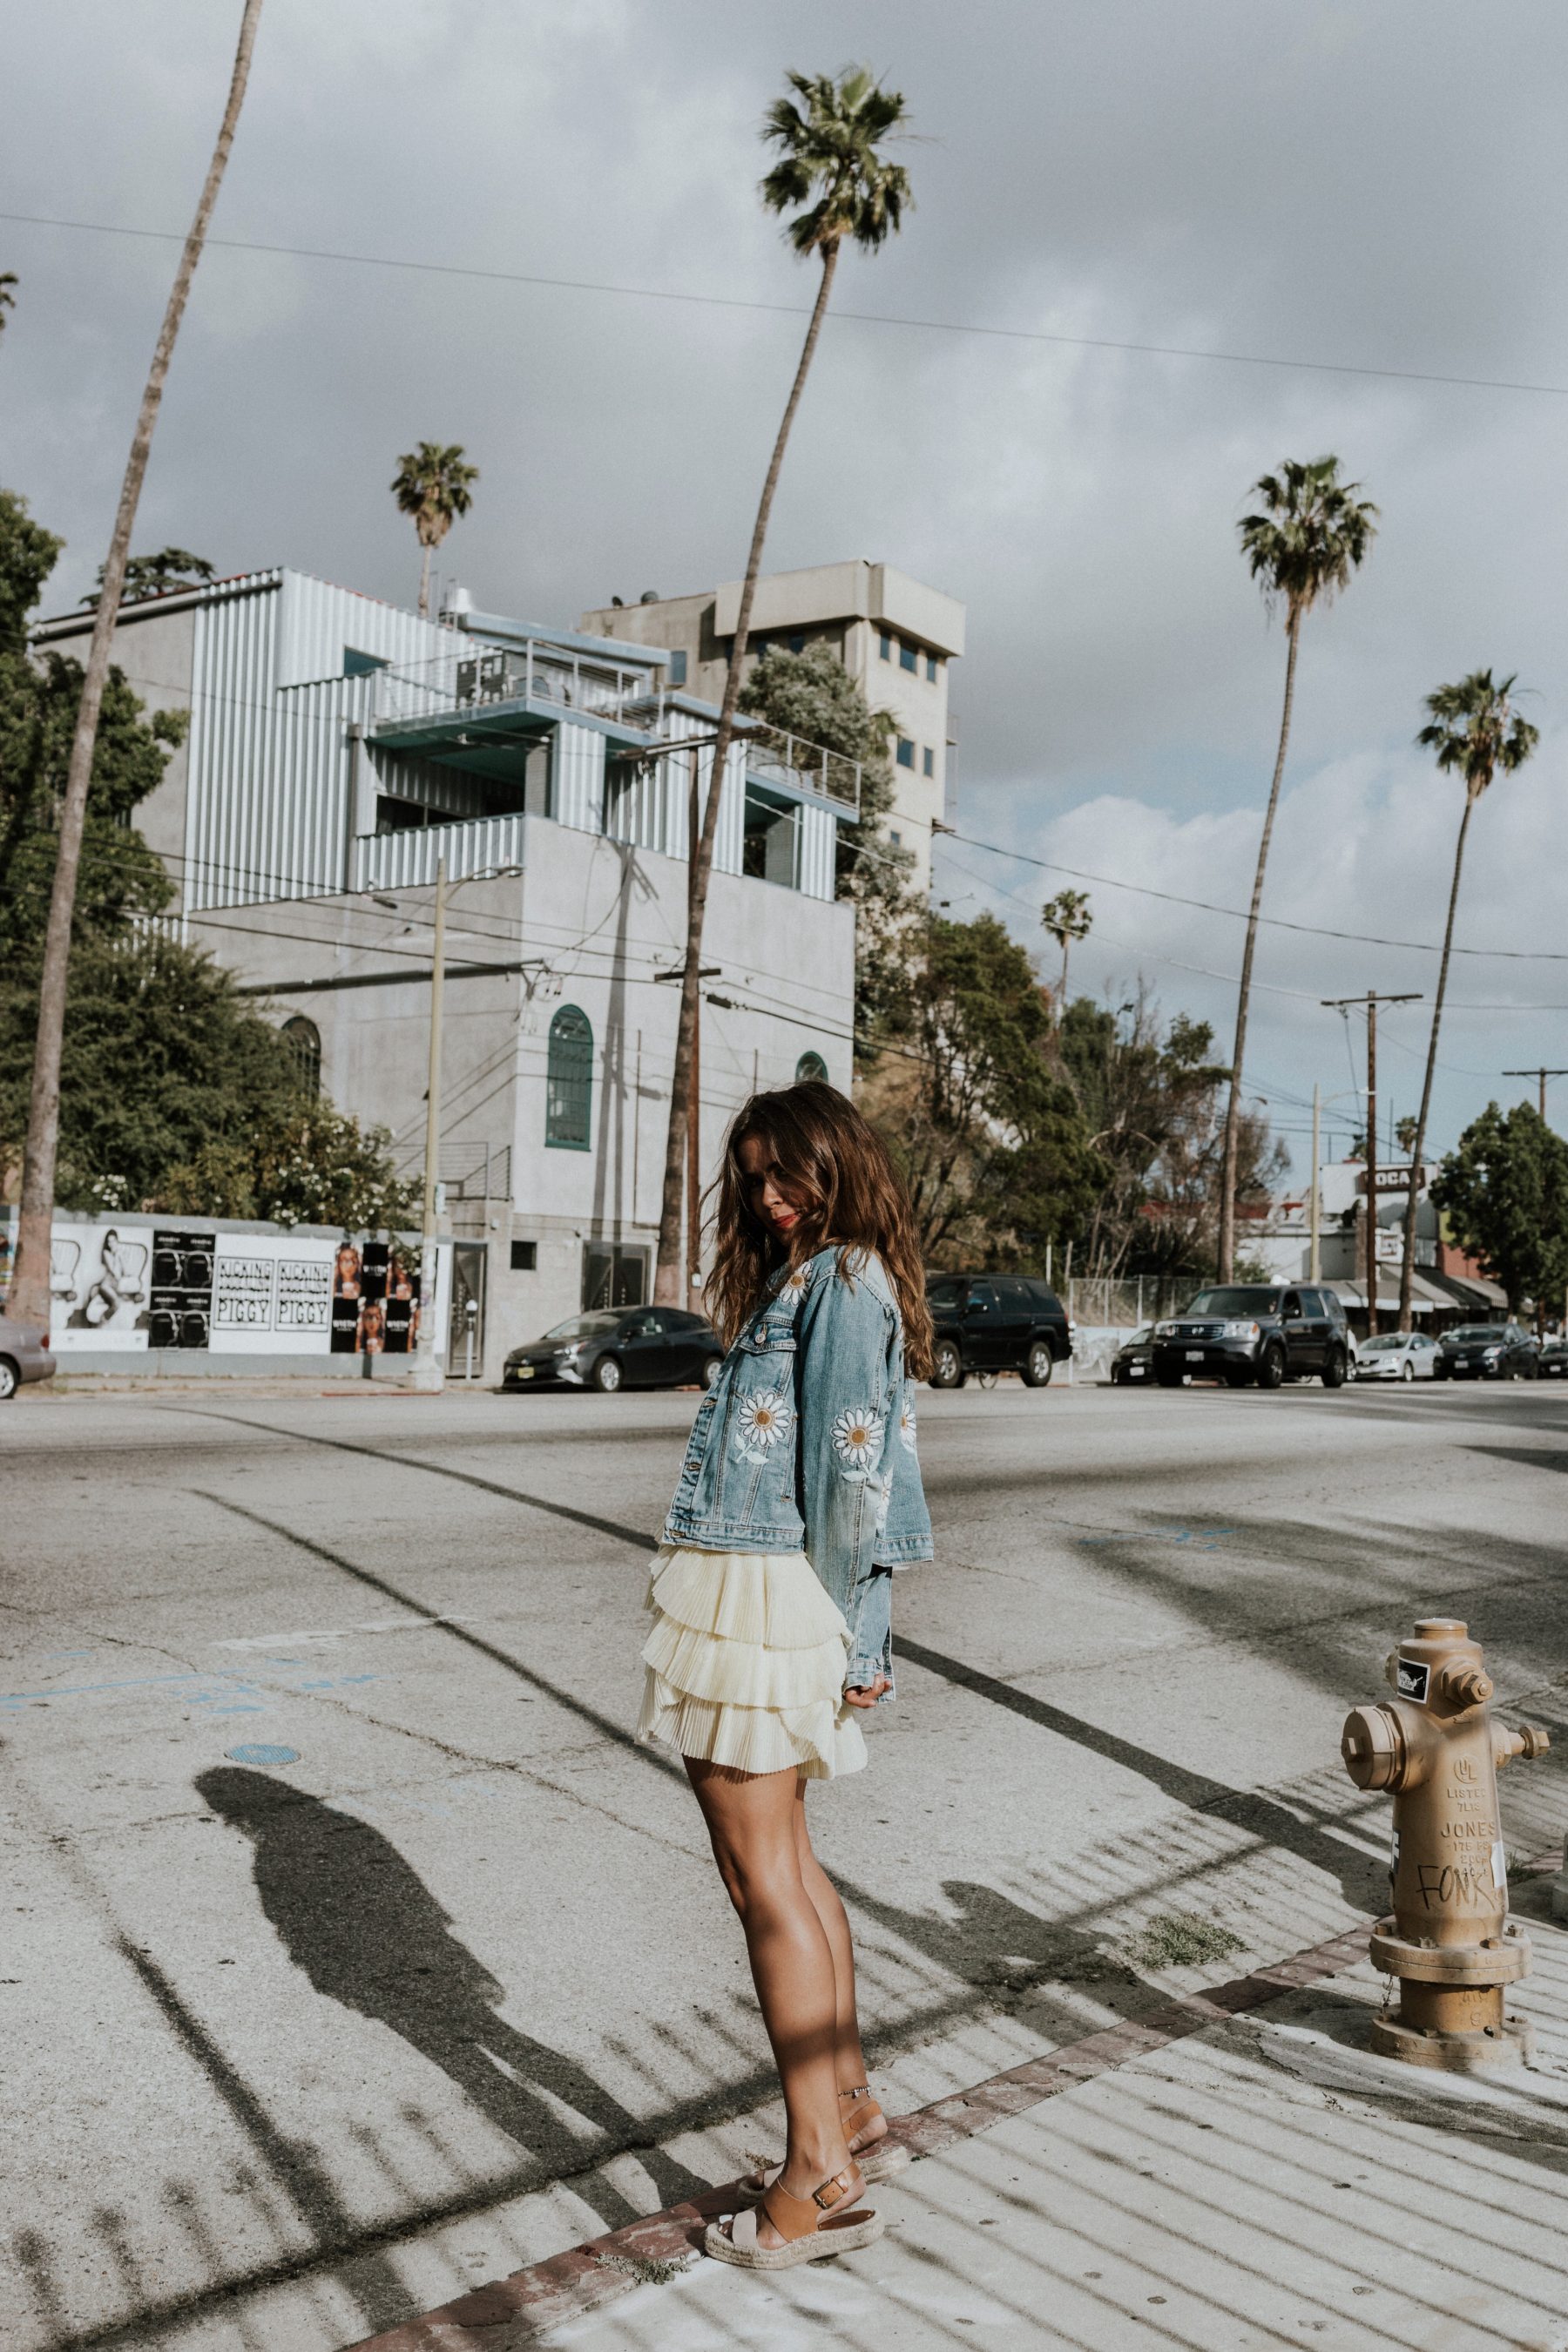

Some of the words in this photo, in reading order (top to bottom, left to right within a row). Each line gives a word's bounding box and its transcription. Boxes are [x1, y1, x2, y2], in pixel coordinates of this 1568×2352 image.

[1365, 1171, 1422, 1186] OCA
[220, 1260, 270, 1281] KICKING
[280, 1264, 328, 1282] KICKING
[218, 1298, 269, 1322] PIGGY
[279, 1301, 327, 1324] PIGGY
[1440, 1820, 1497, 1838] JONES
